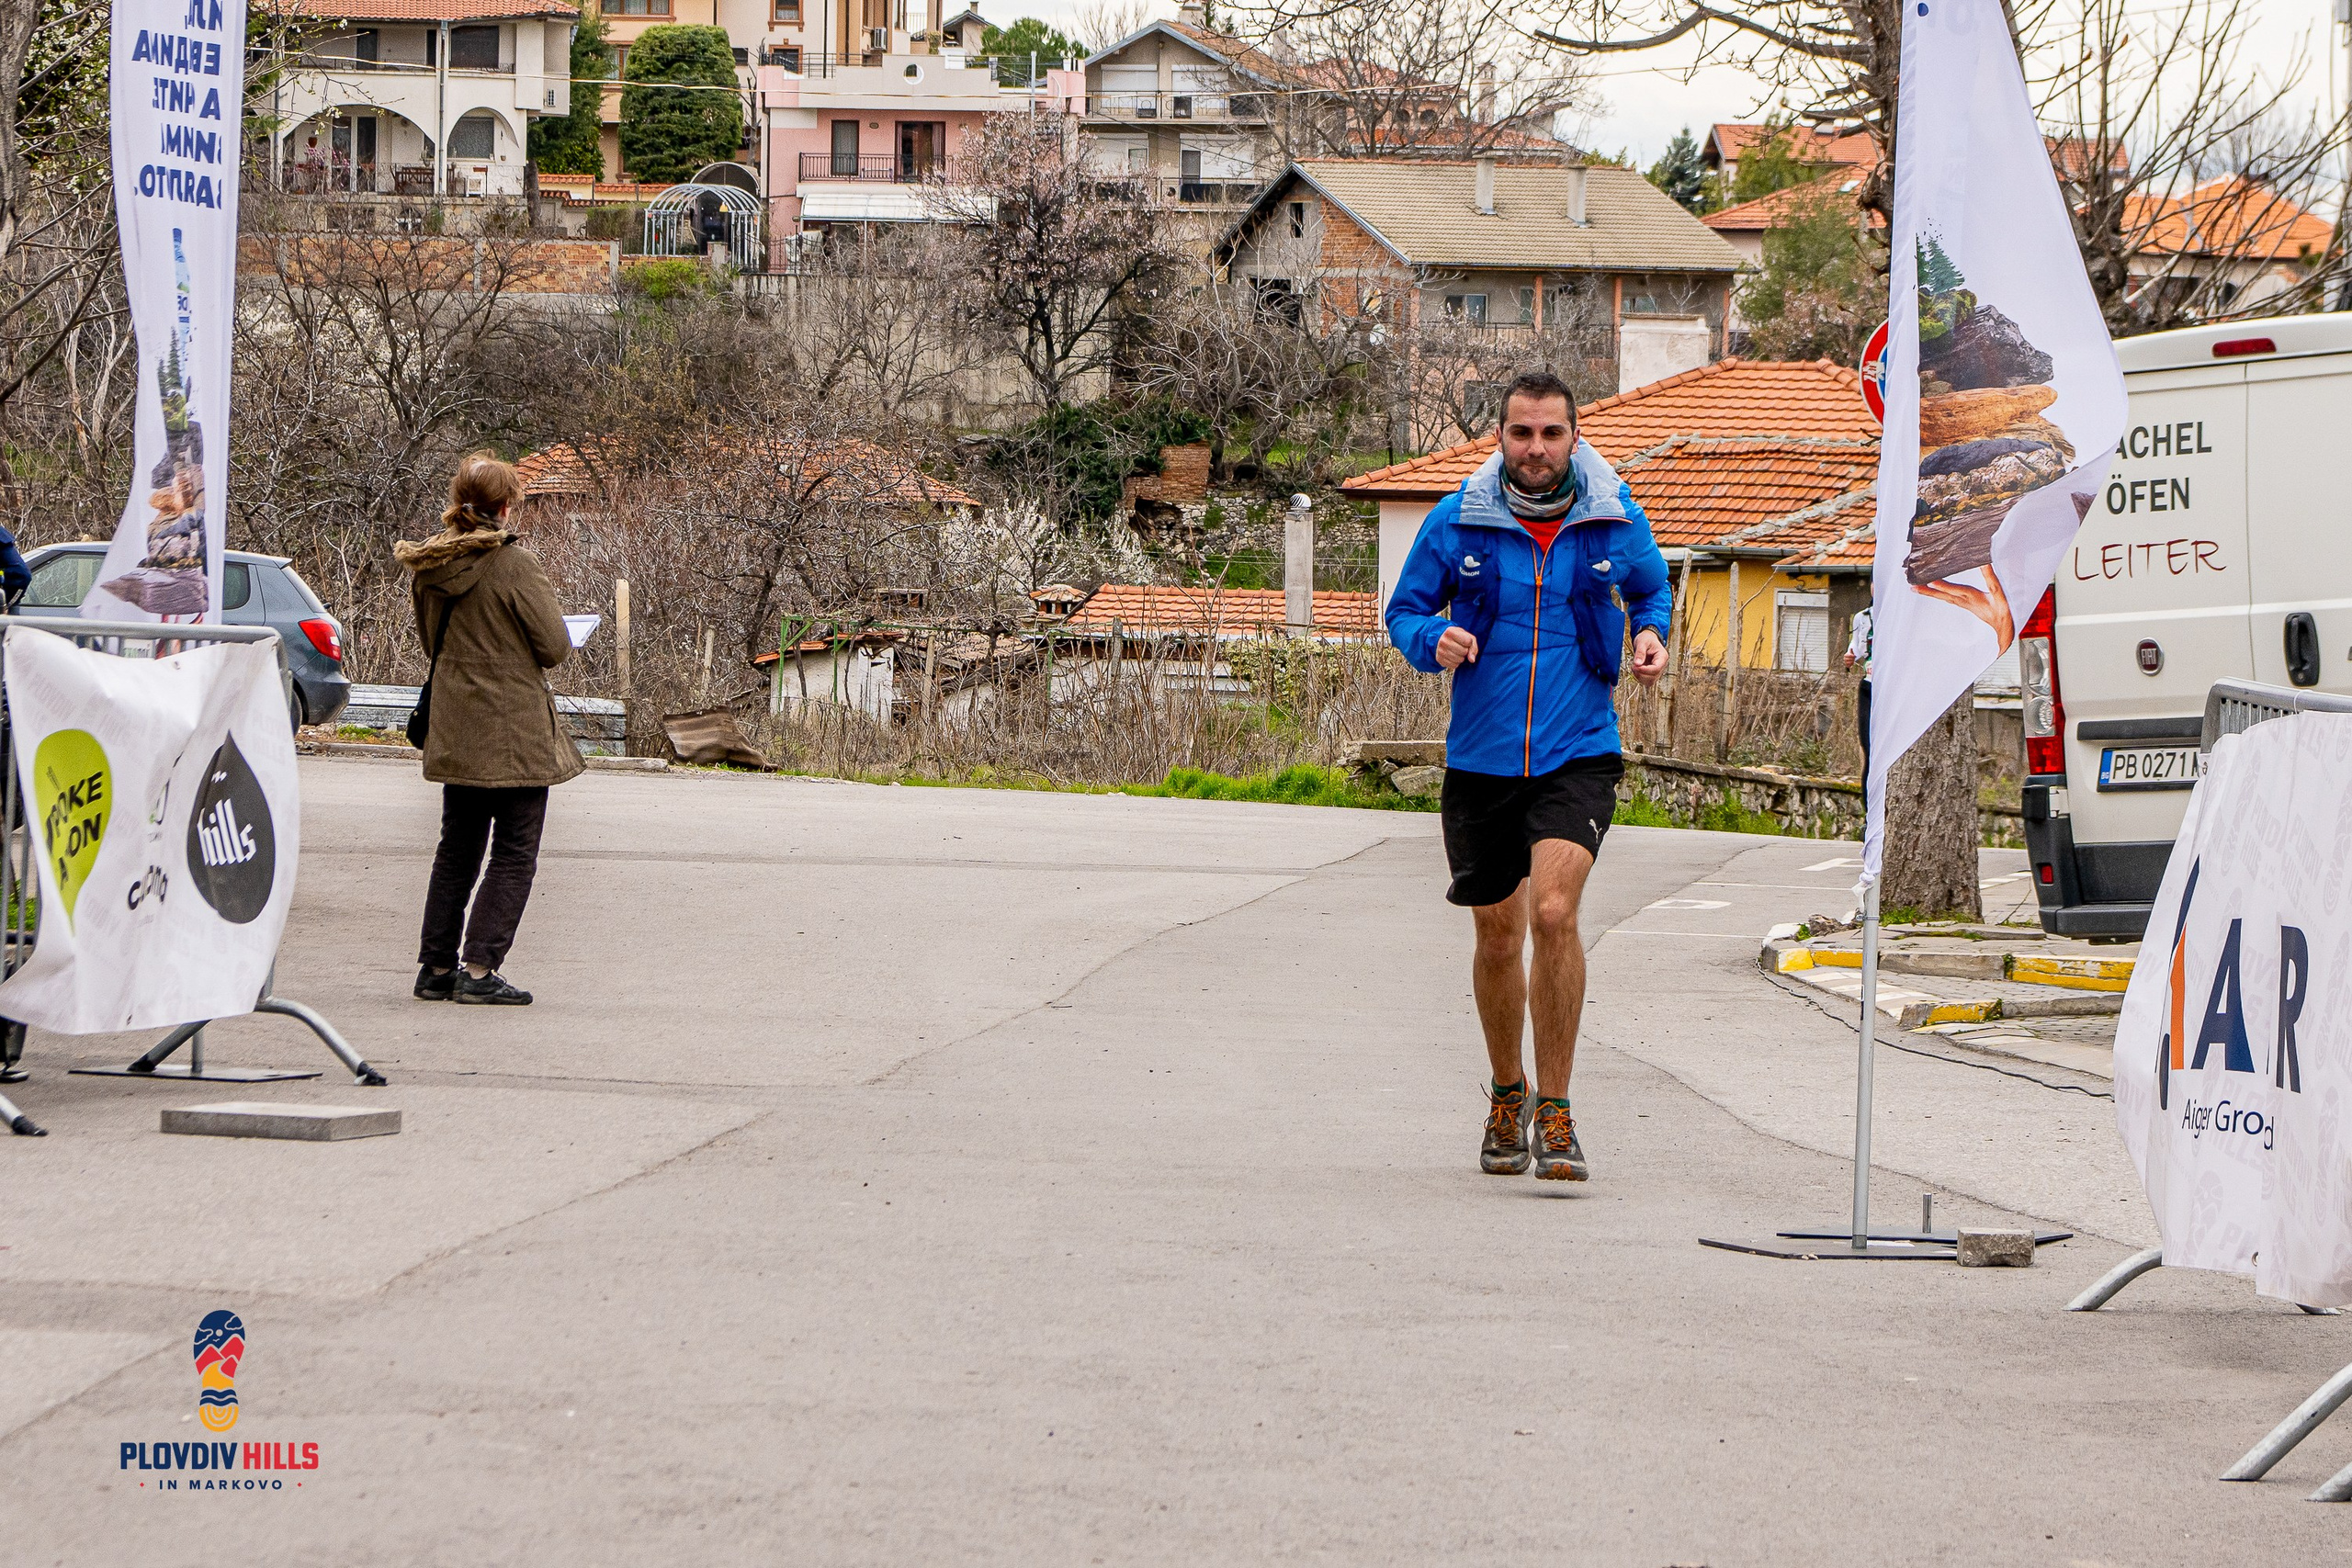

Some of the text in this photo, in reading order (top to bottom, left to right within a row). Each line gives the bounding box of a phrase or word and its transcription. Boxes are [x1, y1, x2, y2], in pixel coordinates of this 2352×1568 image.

[2106, 473, 2190, 515] ÖFEN
[2074, 538, 2228, 582] LEITER
[2141, 648, 2157, 665] FIAT
[2112, 753, 2137, 780] PB
[2142, 751, 2188, 778] 0271
[197, 797, 257, 867] hills
[2181, 1098, 2213, 1140] Aiger
